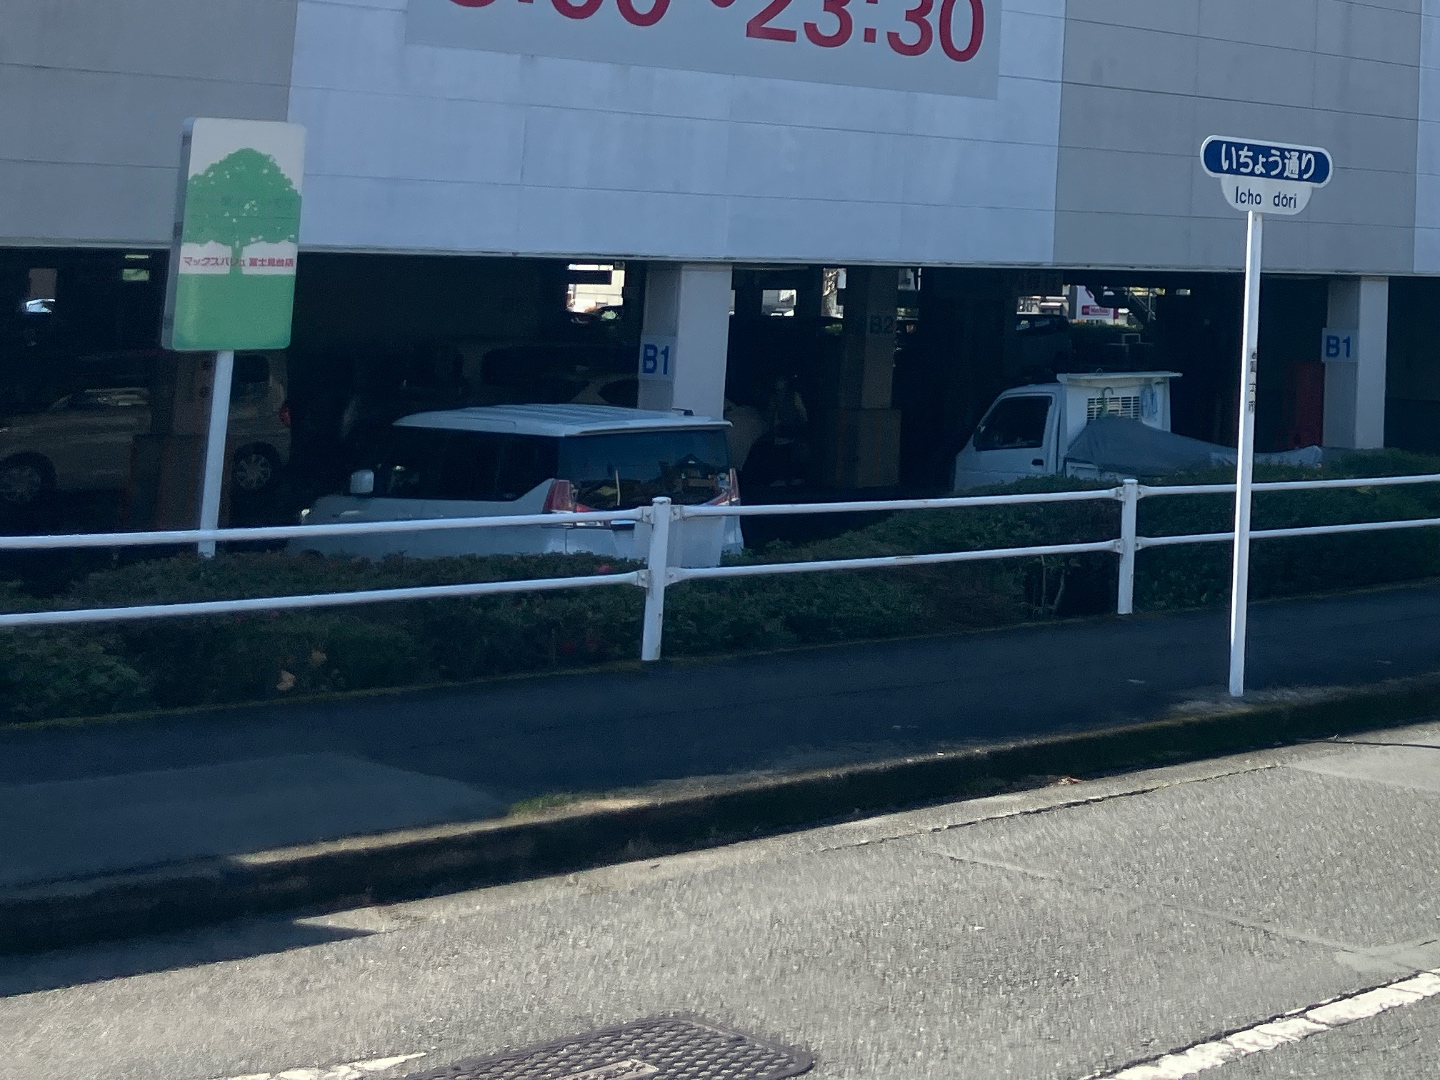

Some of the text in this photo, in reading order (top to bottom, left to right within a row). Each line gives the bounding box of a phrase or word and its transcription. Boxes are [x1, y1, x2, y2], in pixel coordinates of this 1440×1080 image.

[1220, 143, 1316, 180] いちょう通り
[1235, 185, 1262, 205] Icho
[642, 343, 670, 375] B1
[1325, 335, 1351, 358] B1
